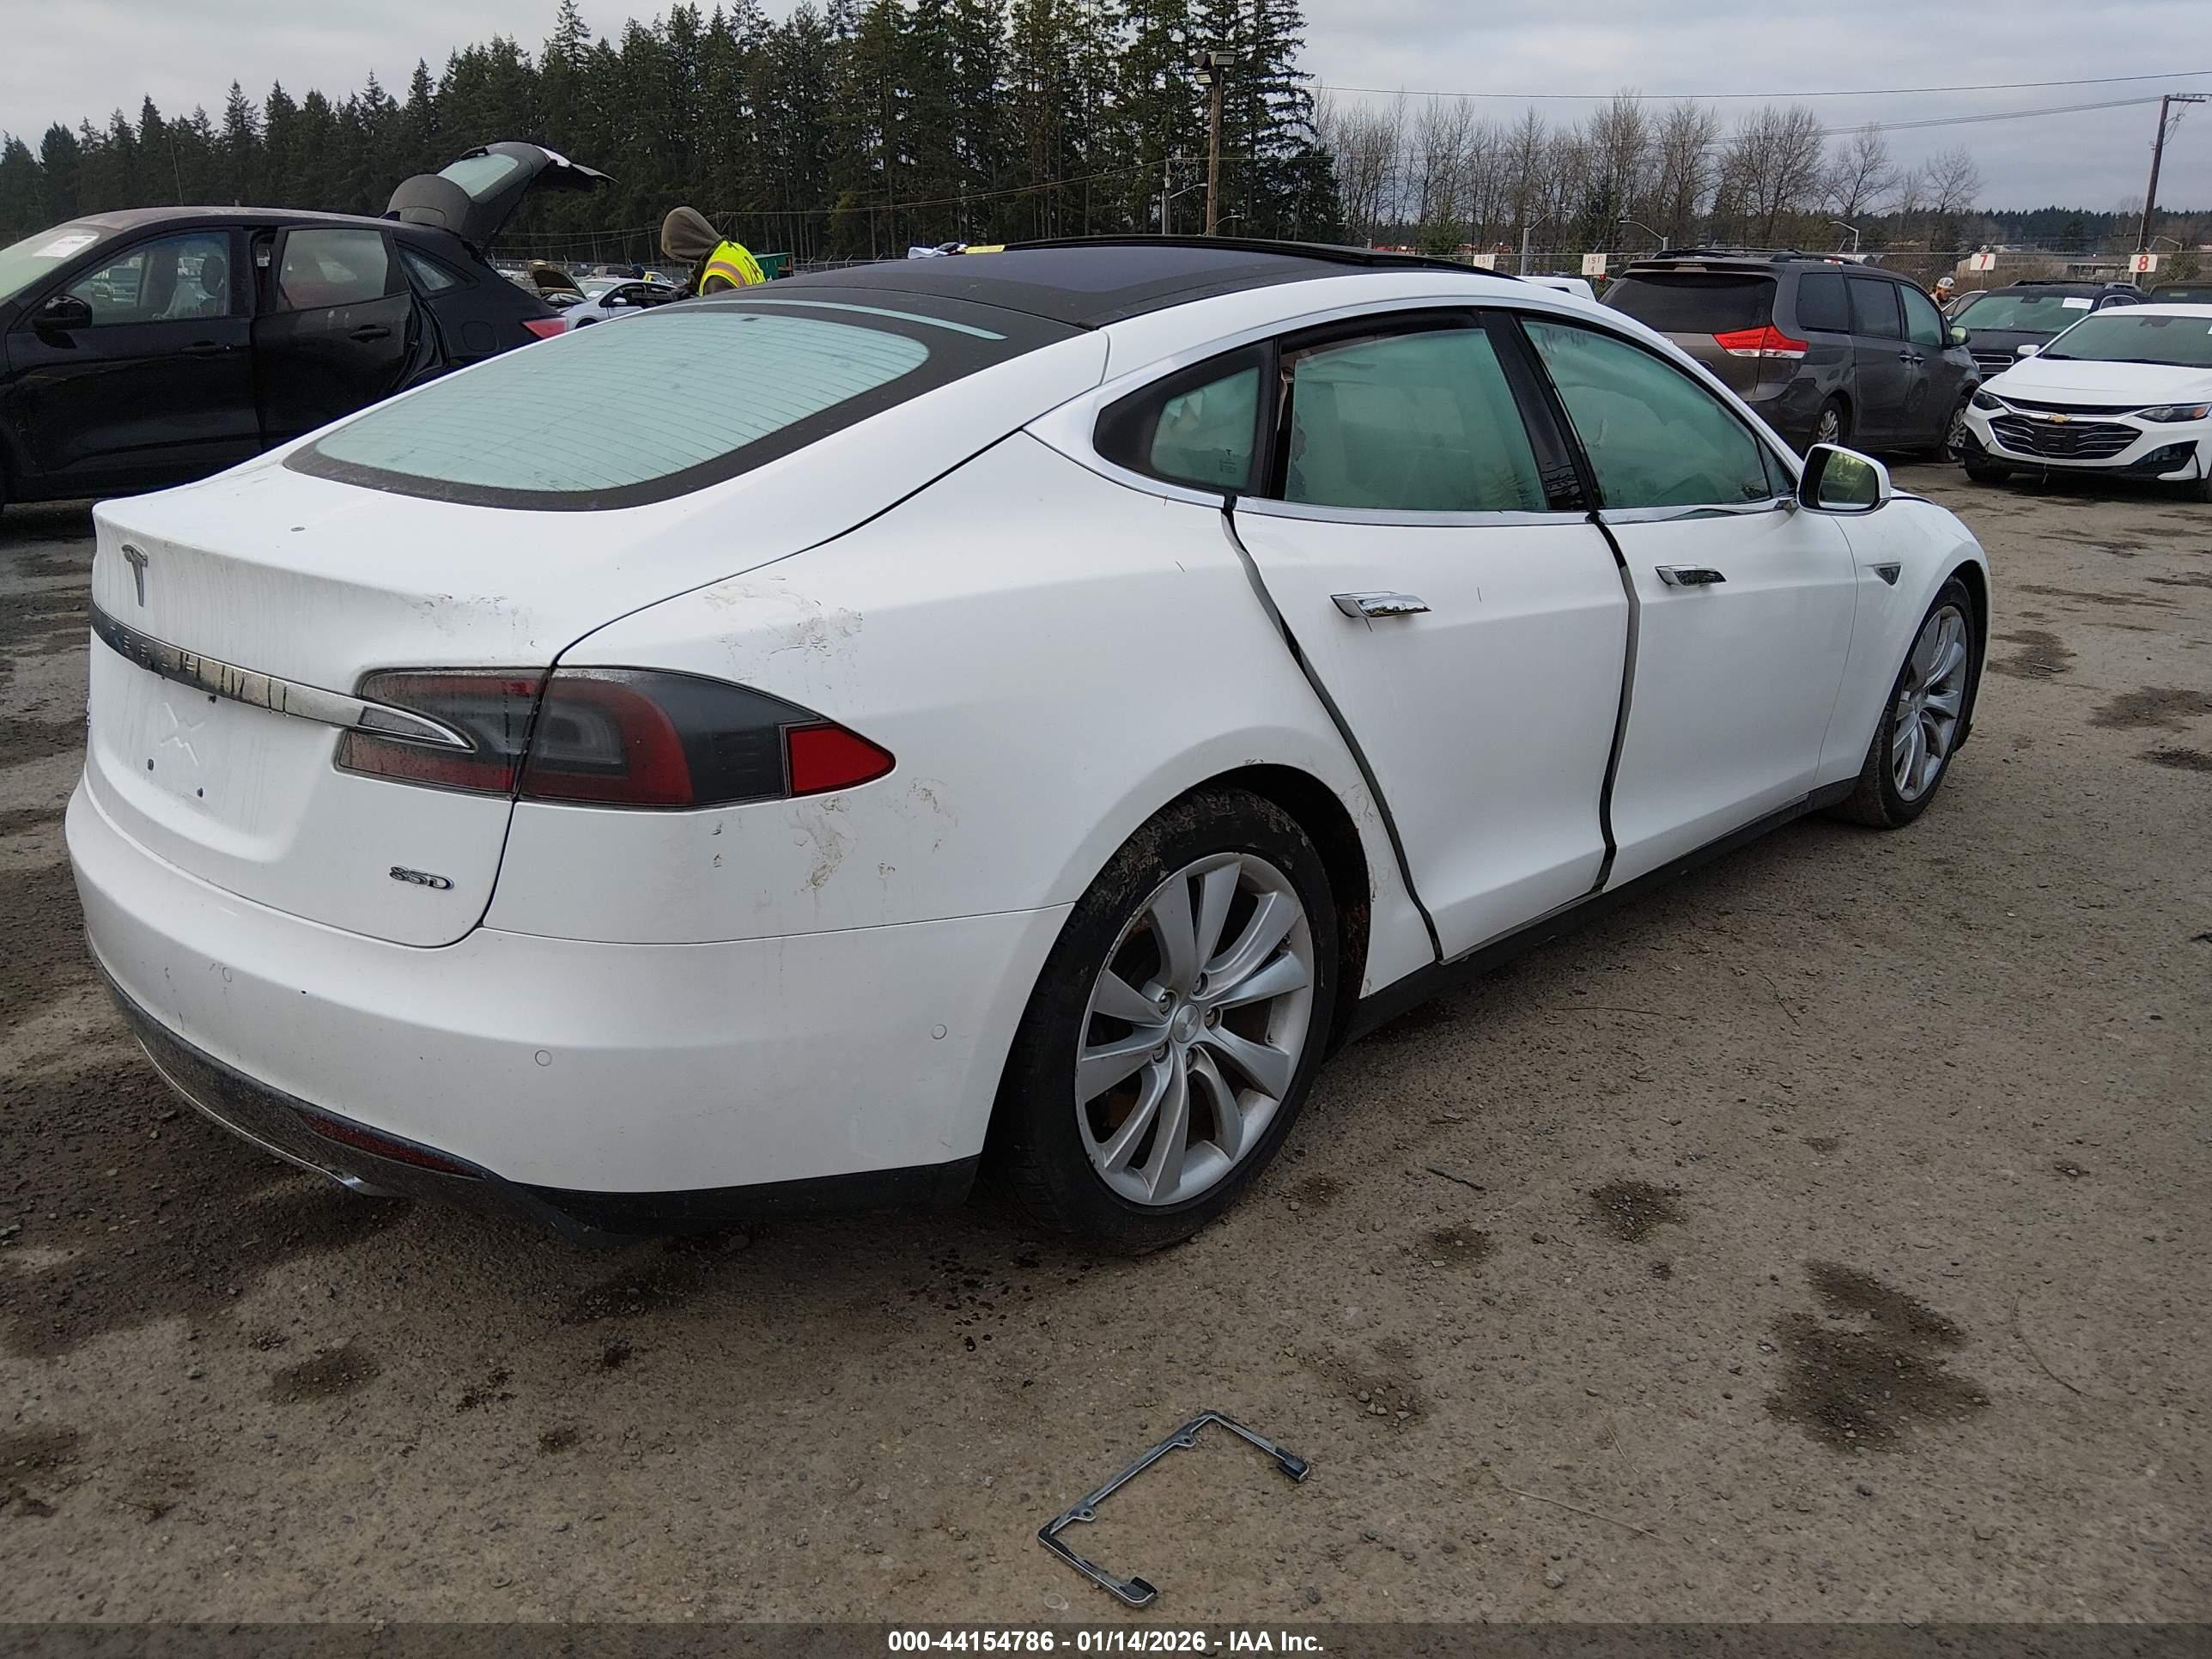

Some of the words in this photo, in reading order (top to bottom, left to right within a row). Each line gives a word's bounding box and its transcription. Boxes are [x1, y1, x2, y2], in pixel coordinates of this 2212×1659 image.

[1979, 254, 1989, 270] 7
[2137, 255, 2148, 271] 8
[389, 865, 454, 890] 85D
